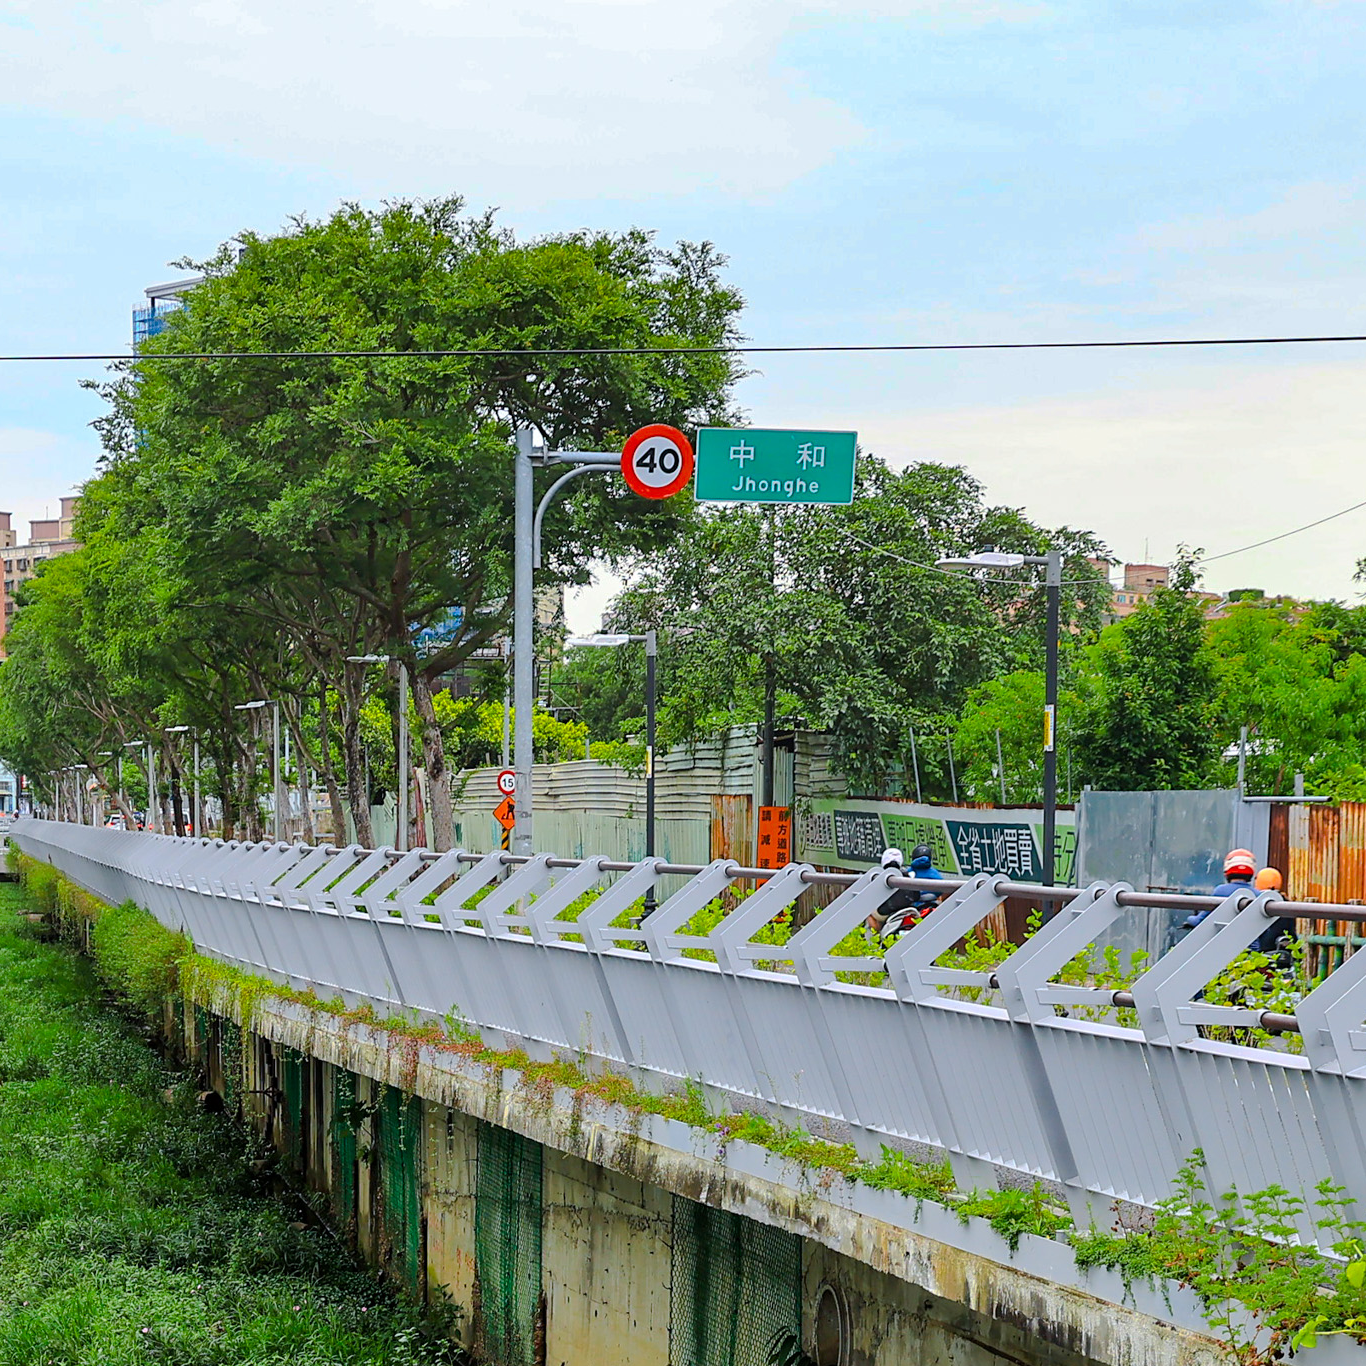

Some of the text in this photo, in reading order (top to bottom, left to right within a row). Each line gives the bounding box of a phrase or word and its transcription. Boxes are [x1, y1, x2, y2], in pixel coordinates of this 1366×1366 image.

[636, 447, 680, 474] 40
[729, 439, 825, 471] 中和
[731, 476, 819, 498] Jhonghe
[502, 778, 514, 788] 15
[776, 810, 787, 869] 前方道路
[957, 825, 1034, 877] 全省土地買賣
